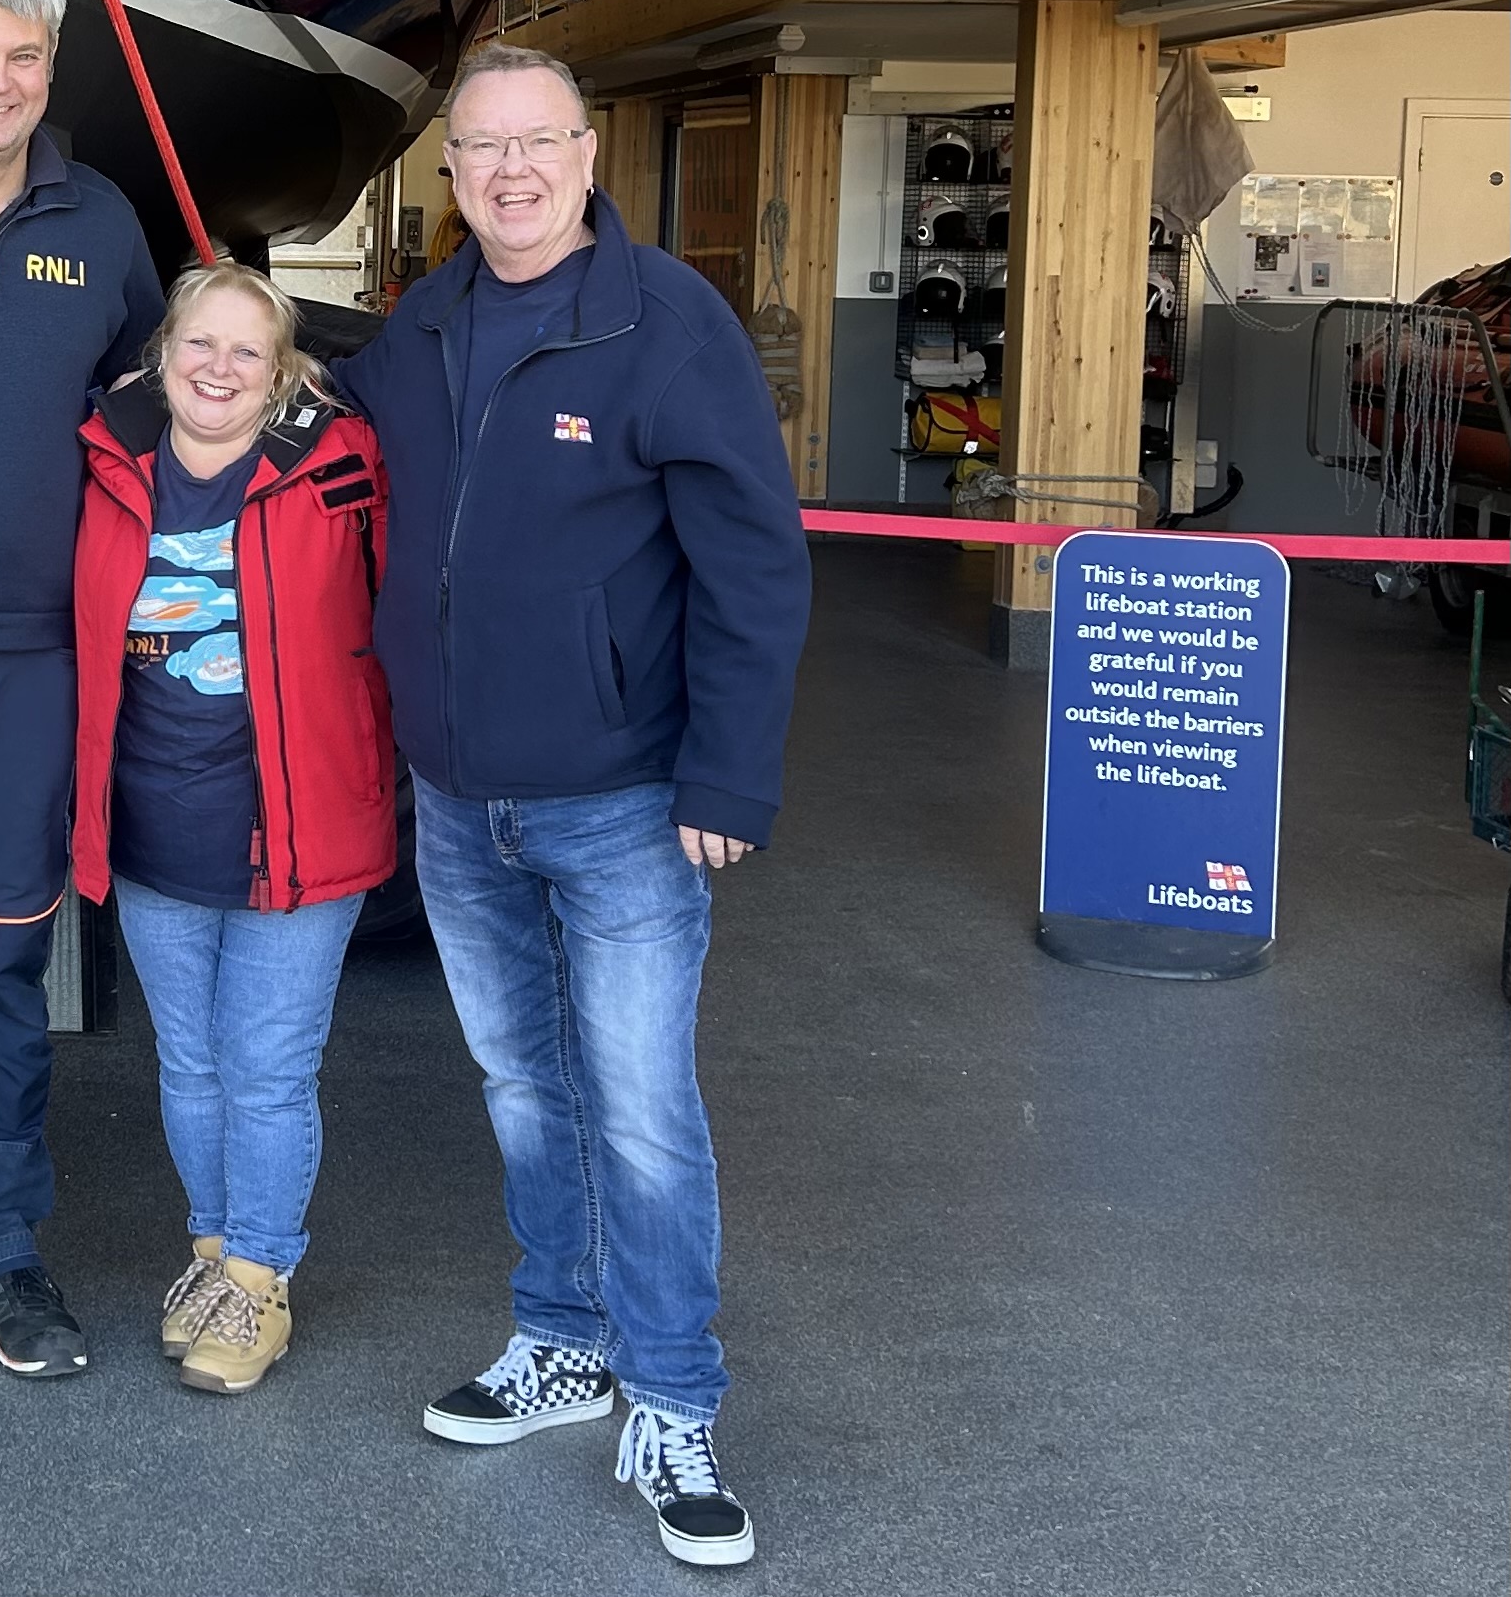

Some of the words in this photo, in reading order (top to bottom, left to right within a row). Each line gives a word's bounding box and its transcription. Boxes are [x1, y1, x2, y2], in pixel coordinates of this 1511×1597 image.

[26, 253, 86, 287] RNLI
[1081, 564, 1125, 585] This
[1130, 567, 1148, 586] is
[1152, 573, 1166, 588] a
[1171, 571, 1261, 599] working
[1085, 592, 1170, 616] lifeboat
[1174, 600, 1252, 622] station
[1077, 621, 1117, 640] and
[1121, 628, 1154, 643] we
[1158, 628, 1226, 648] would
[1231, 630, 1259, 651] be
[1088, 652, 1175, 673] grateful
[1180, 655, 1197, 675] if
[1200, 661, 1243, 681] you
[1091, 680, 1158, 700] would
[1163, 686, 1239, 707] remain
[1065, 706, 1141, 727] outside
[1145, 709, 1180, 730] the
[1184, 711, 1265, 737] barriers
[1088, 733, 1147, 756] when
[1152, 739, 1238, 769] viewing
[1096, 761, 1132, 782] the
[1137, 764, 1228, 791] lifeboat.
[1148, 884, 1253, 915] Lifeboats
